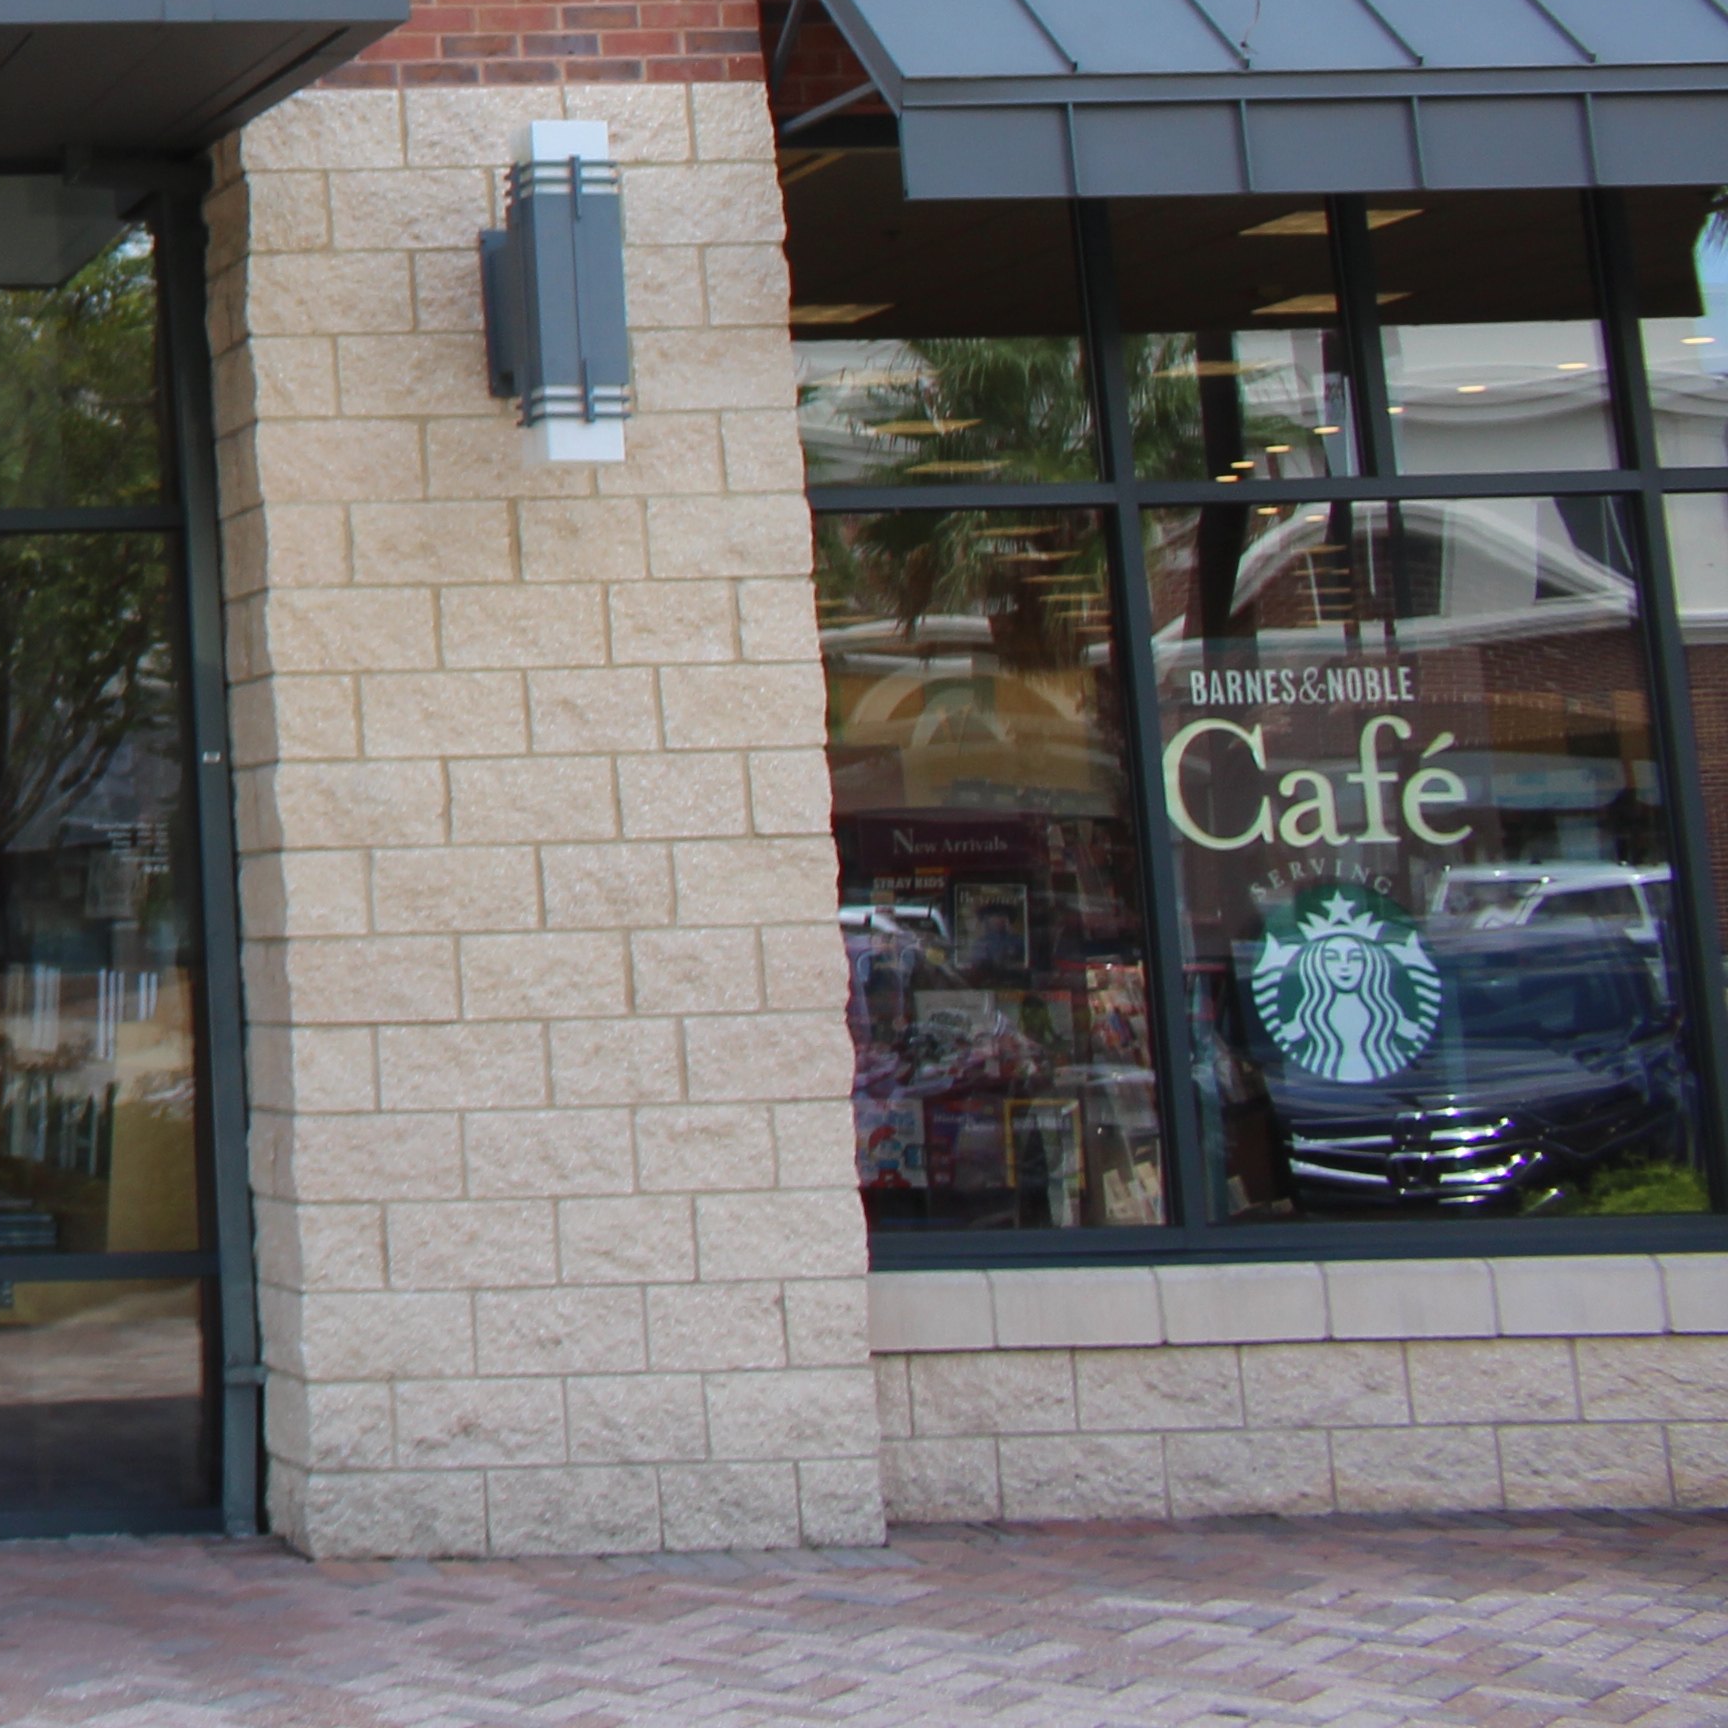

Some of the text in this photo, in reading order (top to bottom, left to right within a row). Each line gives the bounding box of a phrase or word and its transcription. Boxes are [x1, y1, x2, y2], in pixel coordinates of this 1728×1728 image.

[1162, 715, 1472, 850] Café
[892, 828, 1008, 854] New Arrivals
[1249, 857, 1392, 896] SERVING
